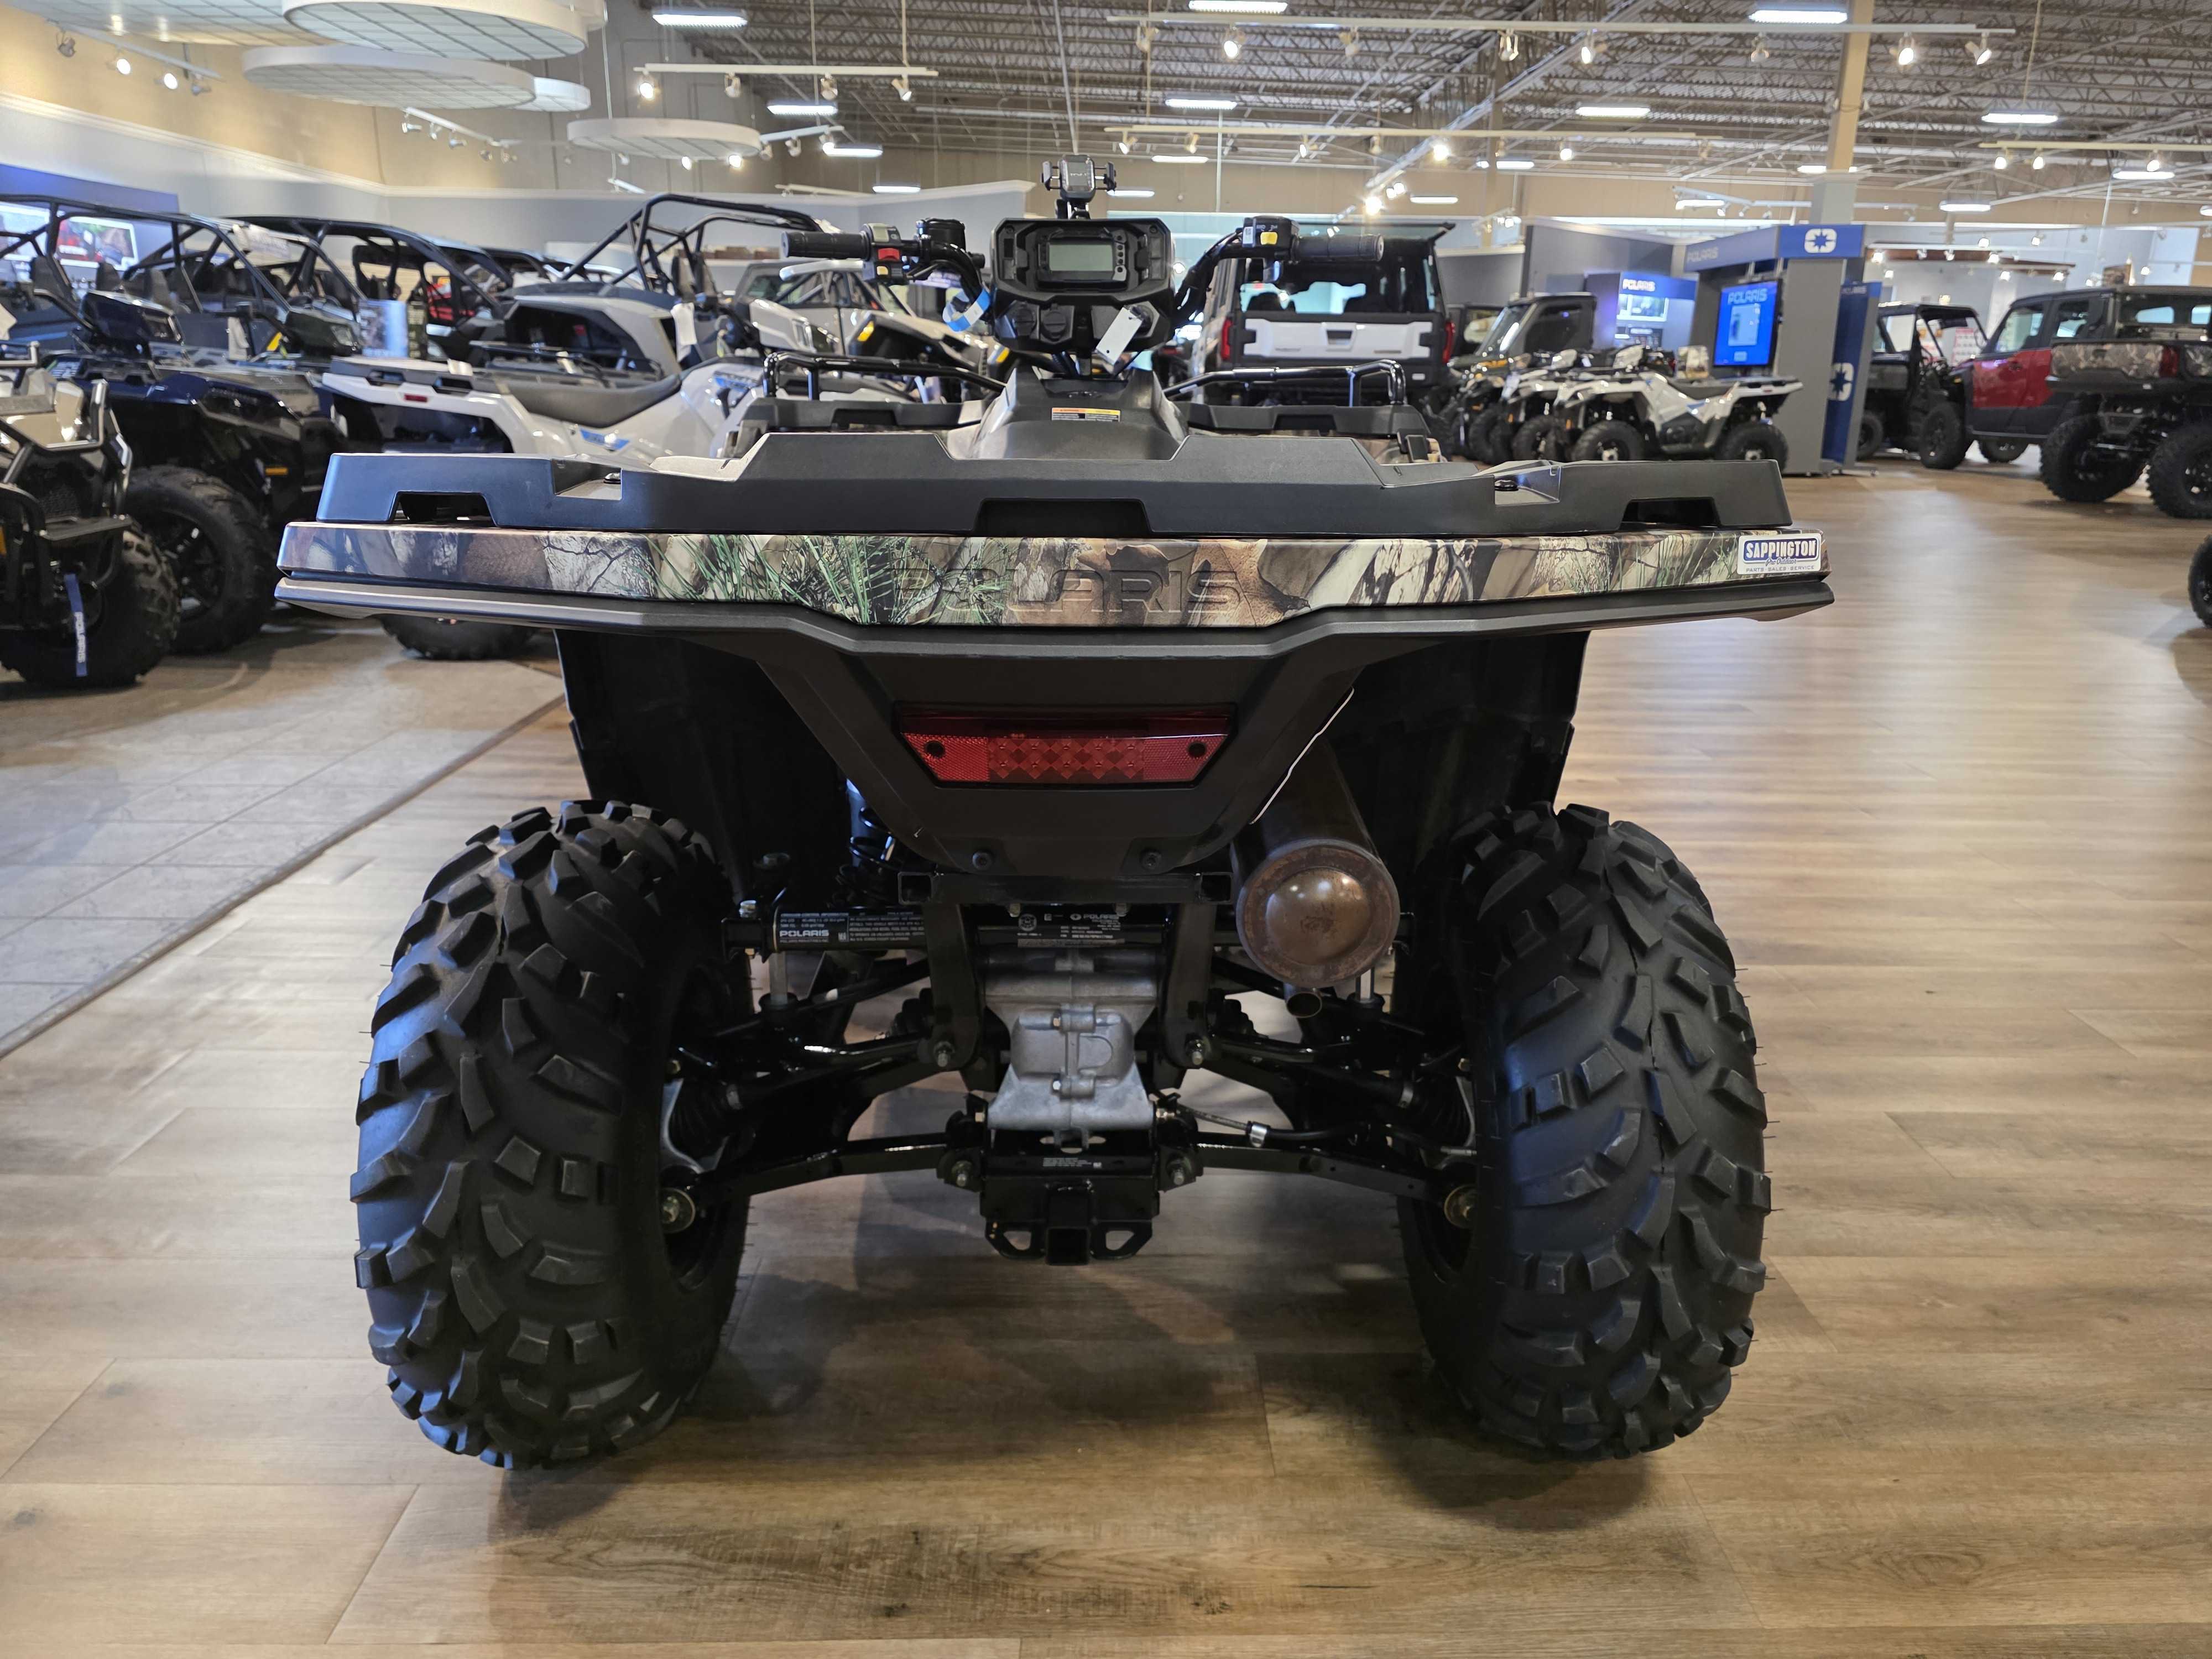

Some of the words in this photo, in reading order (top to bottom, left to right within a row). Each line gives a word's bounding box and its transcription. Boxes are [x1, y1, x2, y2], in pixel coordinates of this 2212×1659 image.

[1622, 279, 1655, 292] POLARIS
[1727, 288, 1768, 305] POLARIS
[1746, 540, 1816, 558] SAPPINGTON
[74, 611, 86, 664] POLARIS
[779, 929, 830, 937] POLARIS
